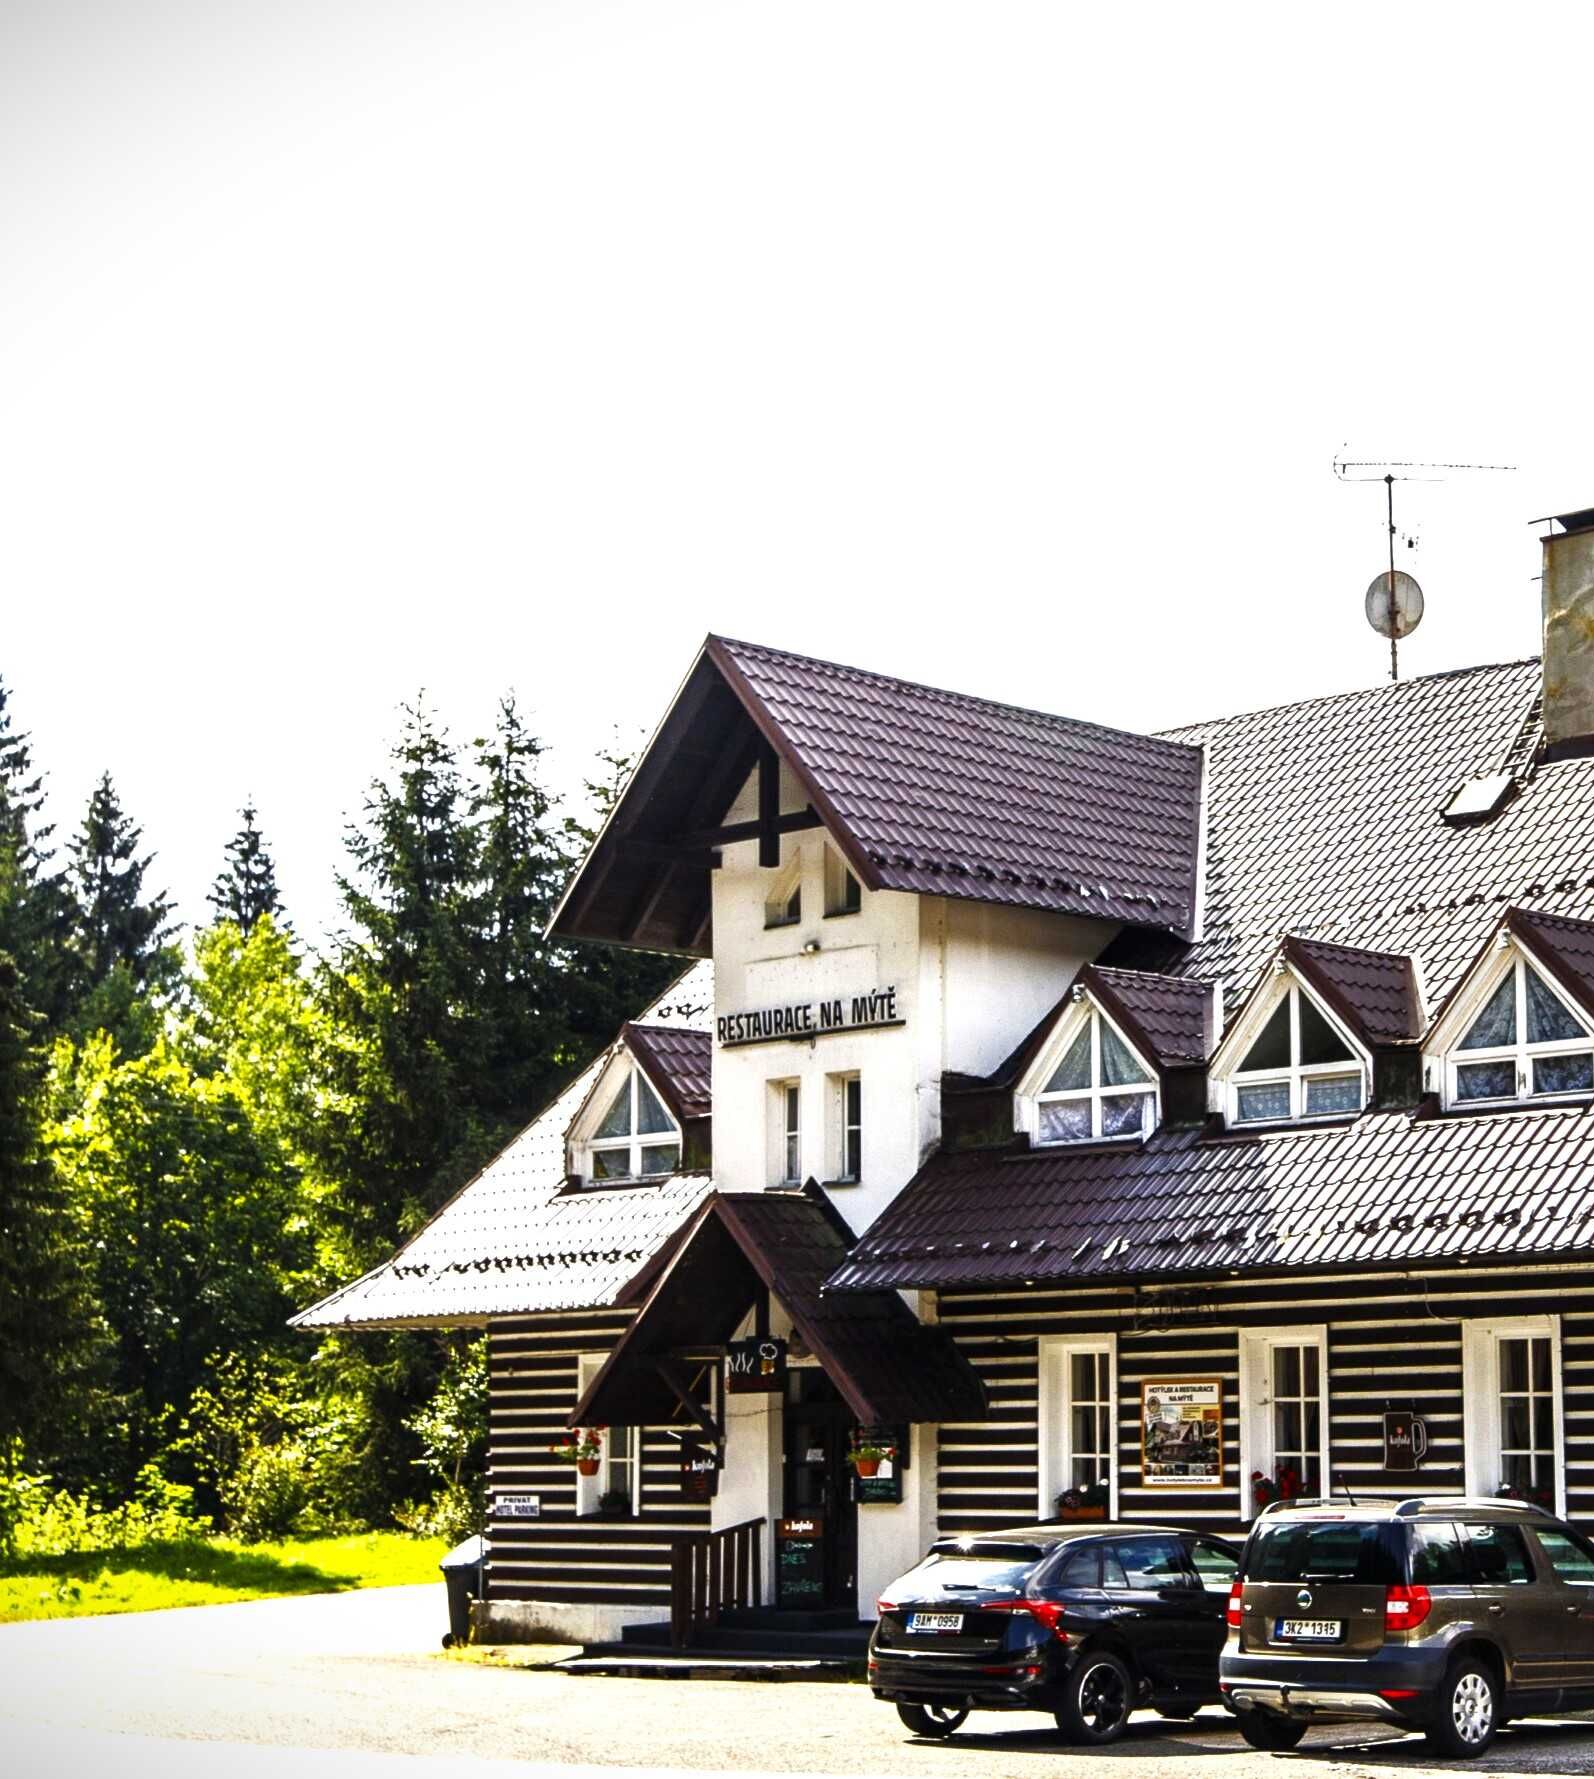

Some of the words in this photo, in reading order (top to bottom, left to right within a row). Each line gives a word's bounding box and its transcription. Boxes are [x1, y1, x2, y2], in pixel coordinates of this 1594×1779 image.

[717, 1004, 812, 1042] RESTAURACE
[820, 1000, 844, 1029] NA
[851, 986, 897, 1025] MÝTĚ
[1284, 1621, 1303, 1635] 3K2
